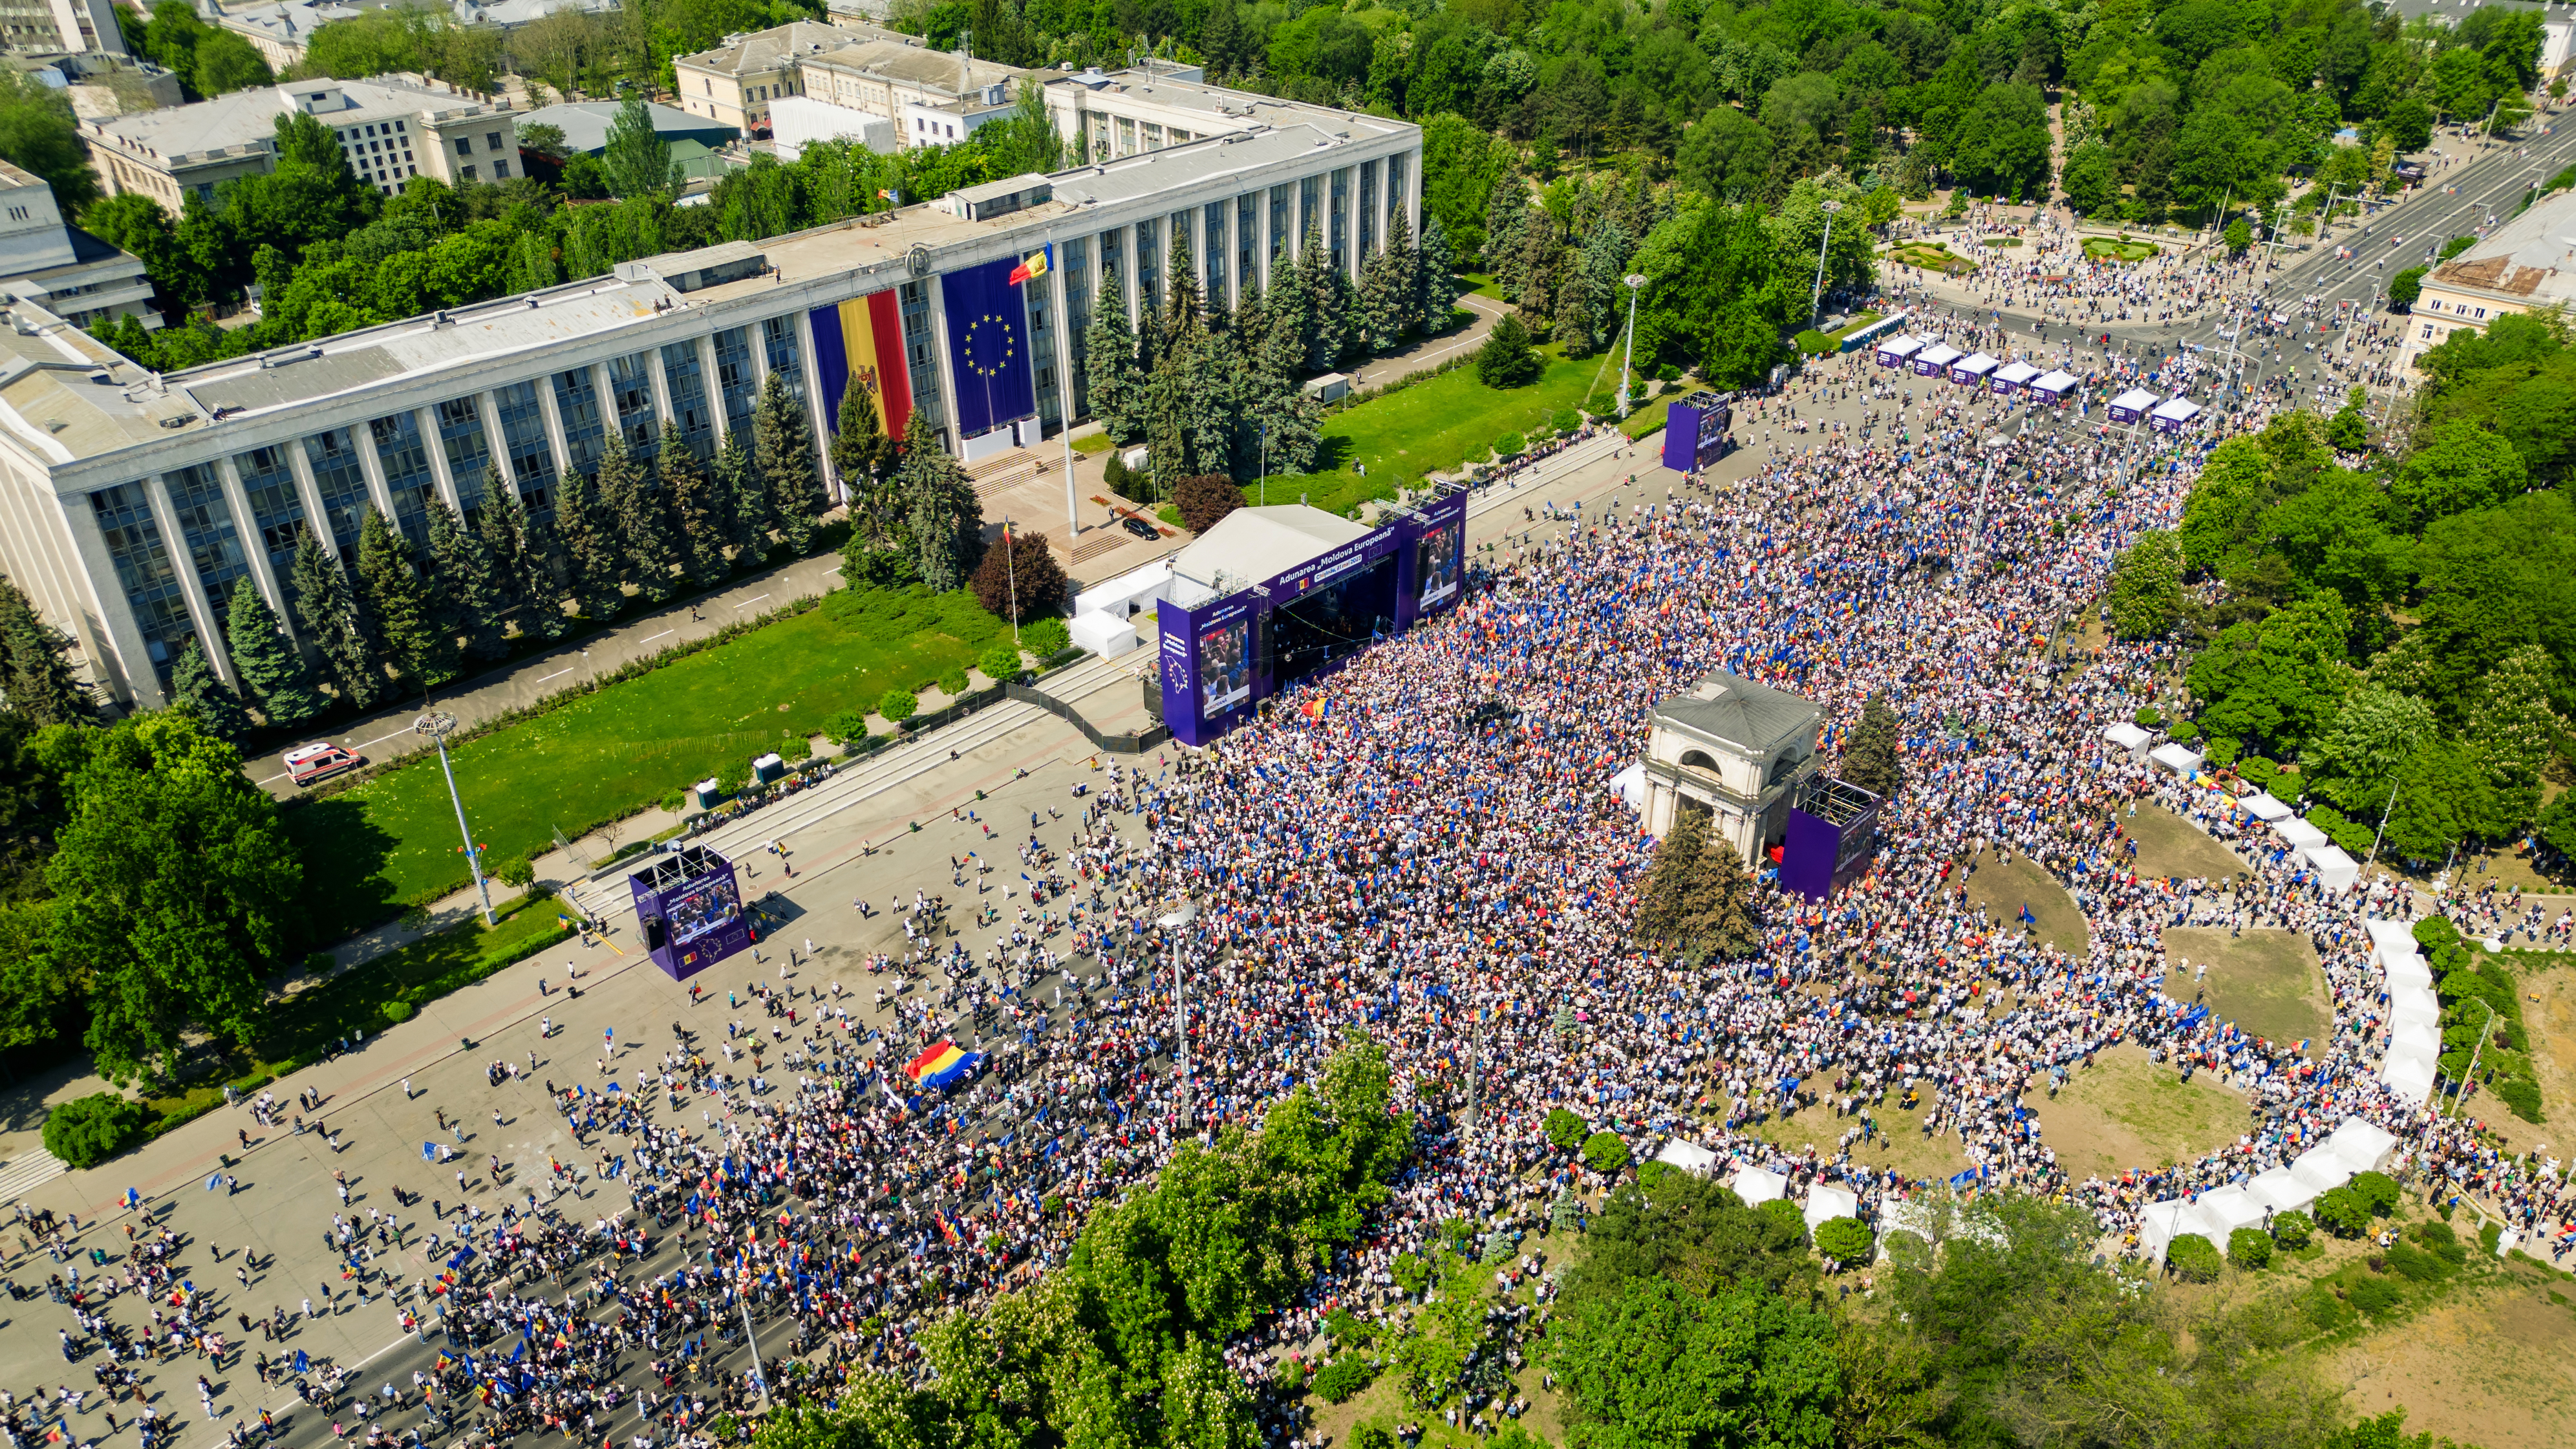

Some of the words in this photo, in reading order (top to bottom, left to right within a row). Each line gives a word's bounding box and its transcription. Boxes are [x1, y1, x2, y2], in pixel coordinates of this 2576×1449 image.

[1280, 564, 1316, 586] Adunarea
[1317, 547, 1353, 570] „Moldova
[1212, 605, 1234, 617] Adunarea
[682, 875, 711, 892] Adunarea
